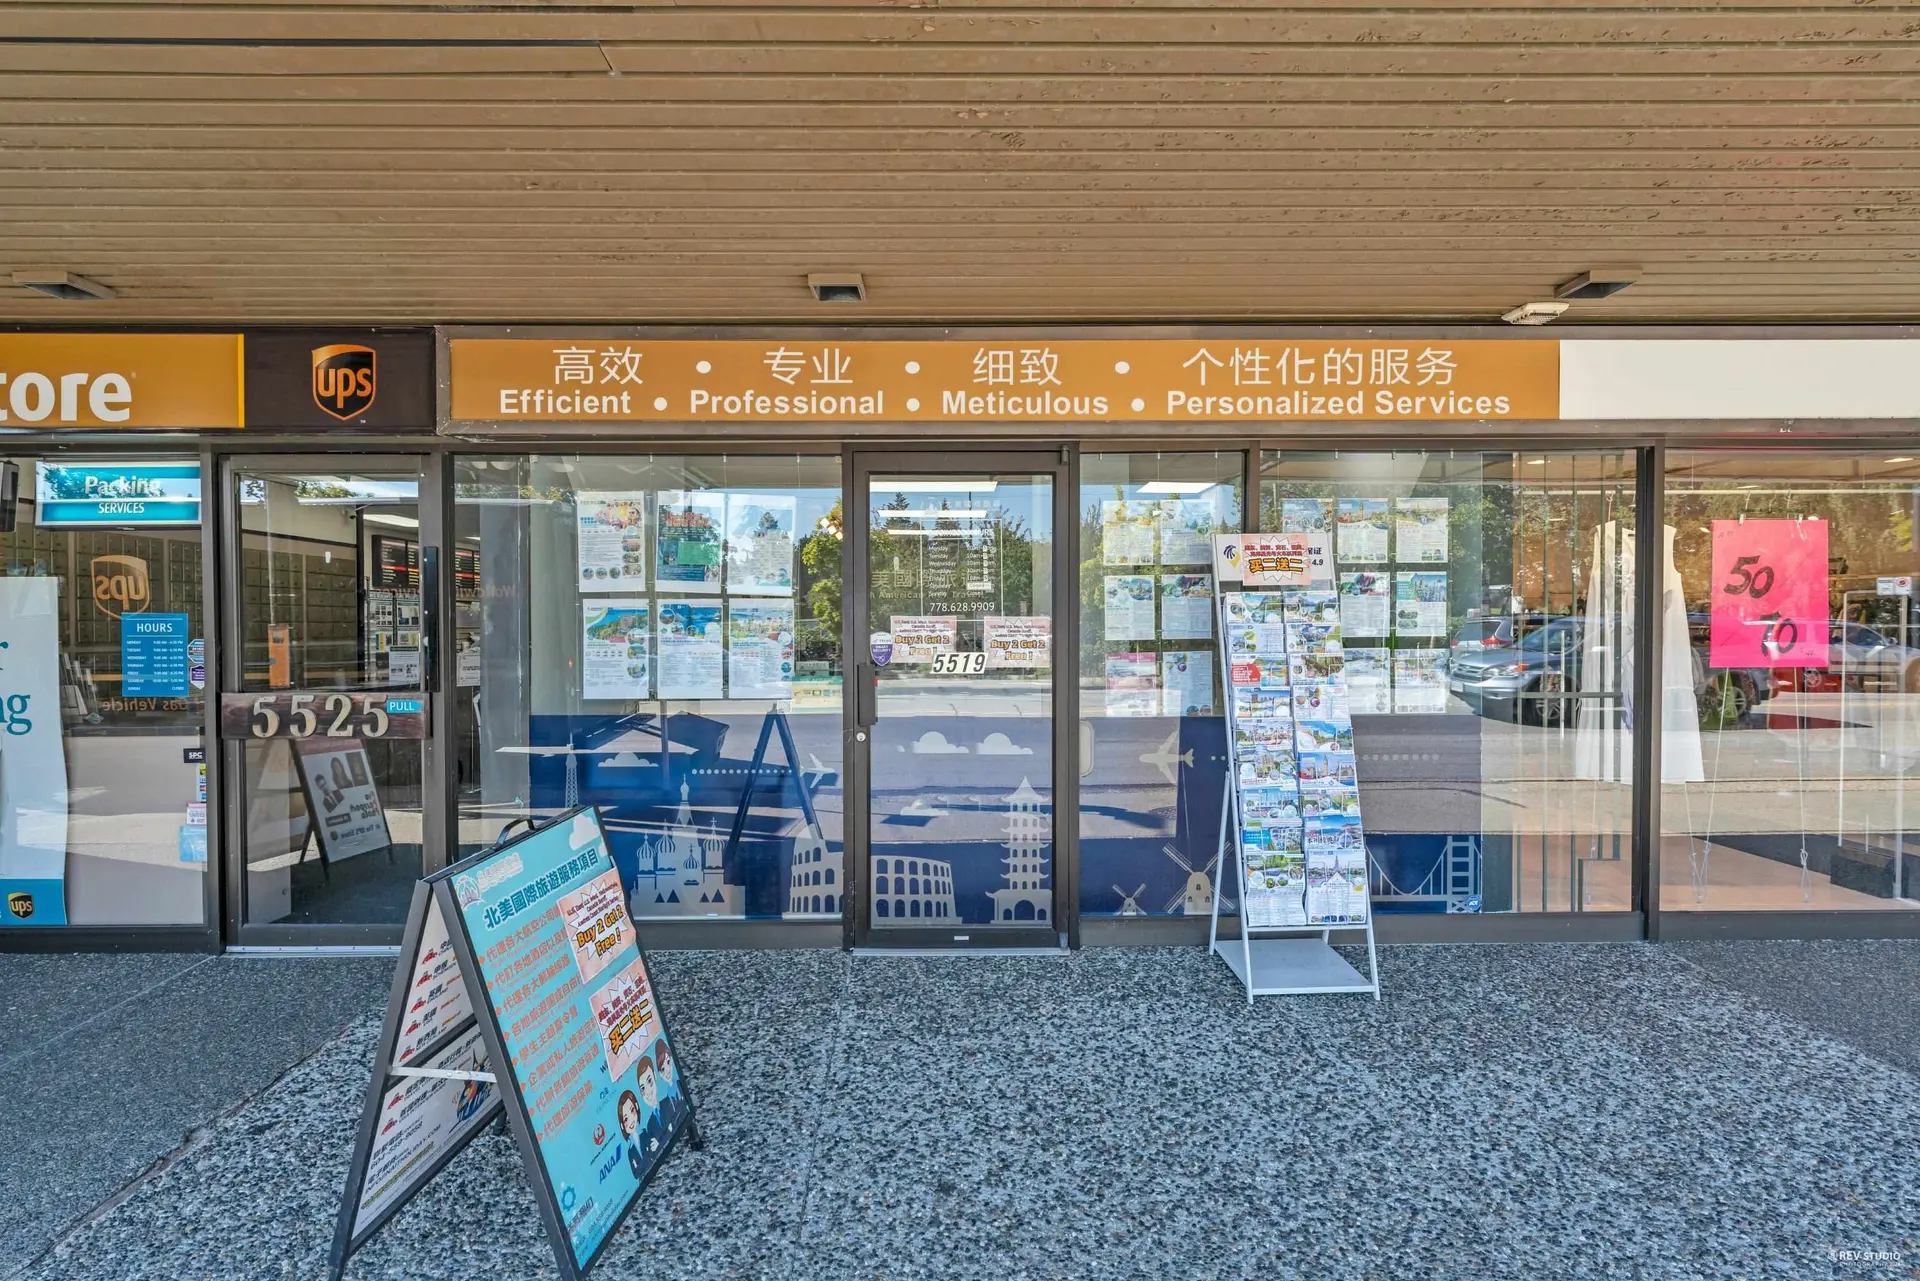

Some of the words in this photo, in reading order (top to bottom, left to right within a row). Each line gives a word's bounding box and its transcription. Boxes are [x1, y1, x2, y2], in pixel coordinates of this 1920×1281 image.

[552, 346, 644, 386] 高效
[762, 346, 854, 386] 专业
[972, 346, 1063, 386] 细致
[1181, 346, 1459, 386] 个性化的服务
[316, 367, 373, 409] ups
[499, 389, 632, 414] Efficient
[689, 389, 885, 414] Professional
[941, 389, 1110, 415] Meticulous
[1166, 389, 1365, 415] Personalized
[1374, 390, 1511, 415] Services
[84, 475, 162, 499] Packing
[97, 501, 146, 515] SERVICES
[1249, 557, 1303, 573] 买二送二
[1723, 555, 1775, 599] 50
[929, 602, 996, 612] 778.628.9909
[136, 622, 173, 633] HOURS
[895, 635, 914, 644] Buy
[924, 635, 941, 643] Get
[991, 640, 1010, 650] Buy
[1011, 640, 1018, 648] 2
[1020, 640, 1037, 648] Get
[1039, 640, 1045, 648] 2
[933, 652, 986, 673] 5519
[251, 693, 390, 738] 5525
[389, 701, 415, 712] PULL
[481, 846, 599, 931] 北美國際旅遊服務項目
[9, 898, 34, 917] ups
[575, 922, 597, 951] Buy
[594, 916, 605, 935] 2
[602, 906, 618, 929] Get
[615, 902, 624, 920] 2
[594, 929, 617, 958] Free
[607, 994, 653, 1056] 买二送二
[596, 1152, 617, 1185] ANA
